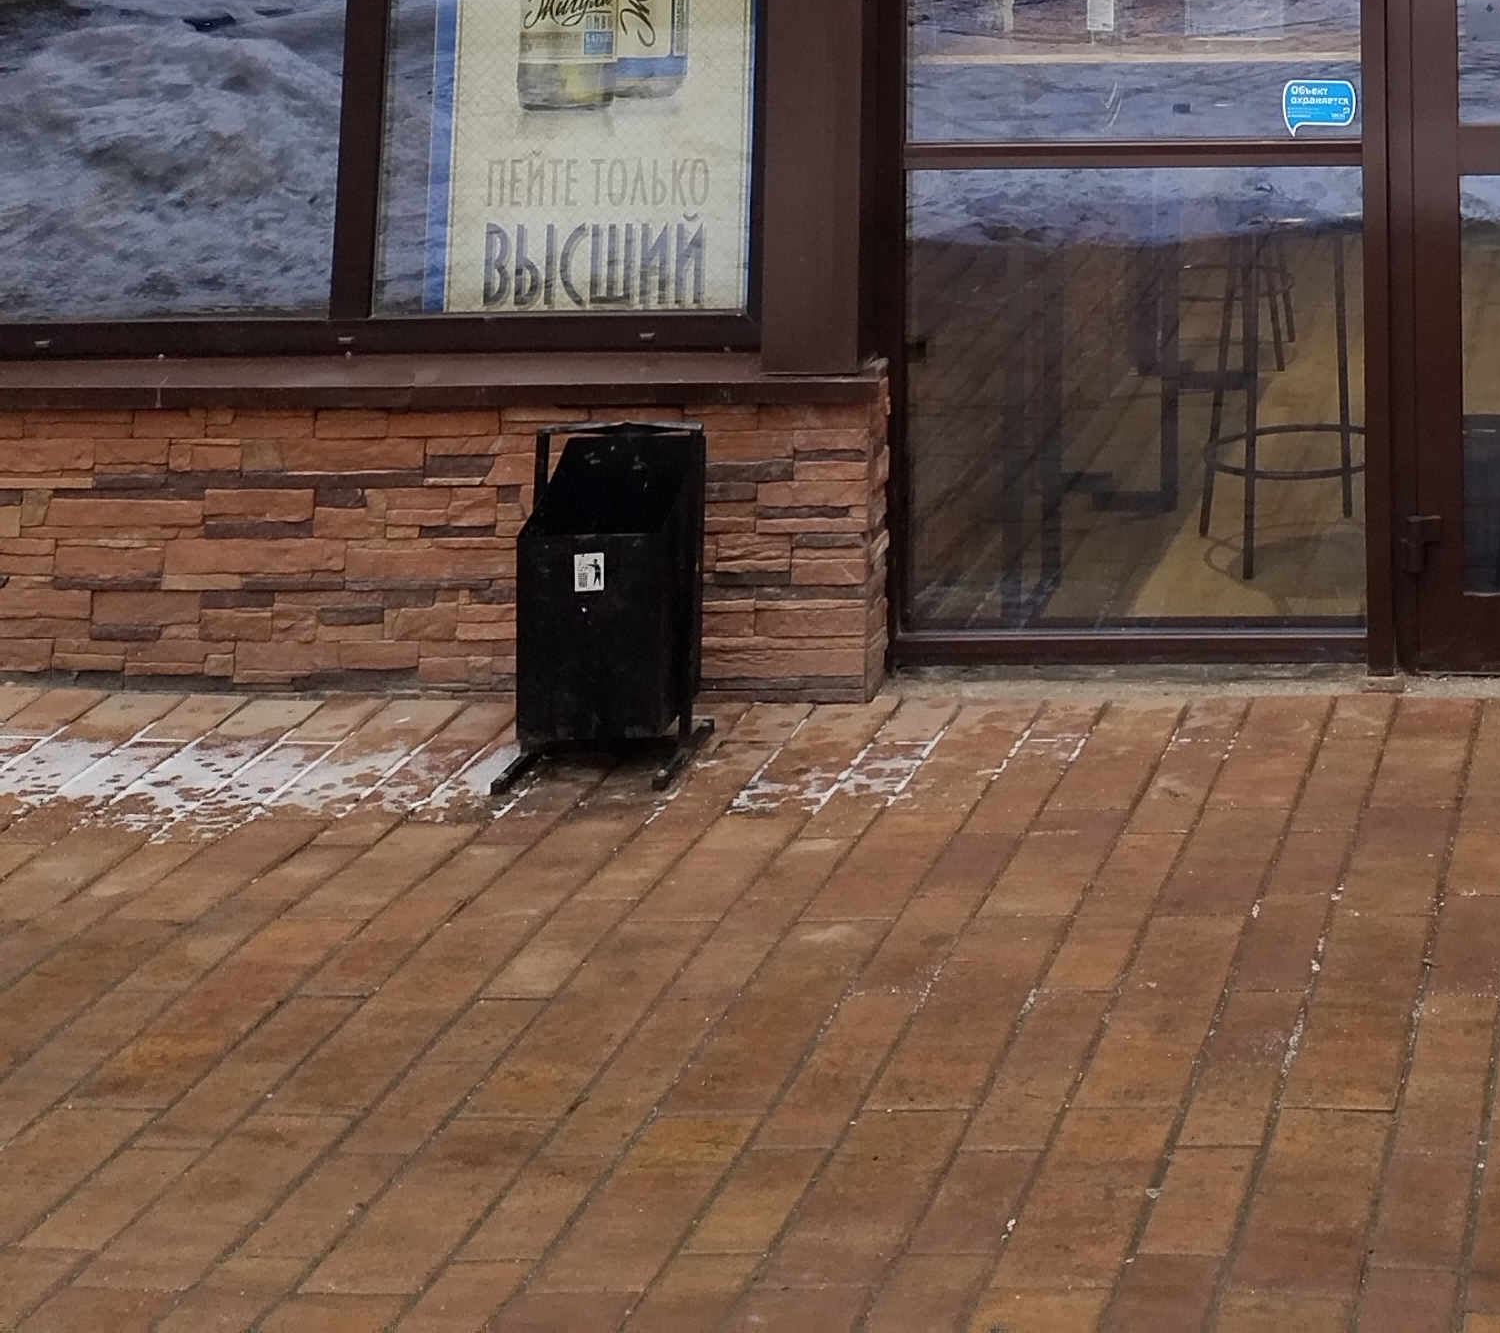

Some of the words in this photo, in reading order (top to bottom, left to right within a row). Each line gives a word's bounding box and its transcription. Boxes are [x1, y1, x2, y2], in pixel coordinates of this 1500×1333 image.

[486, 150, 579, 208] ПЕЙТЕ
[591, 157, 710, 208] ТОЛЬКО
[482, 211, 709, 309] ВЫСШИЙ
